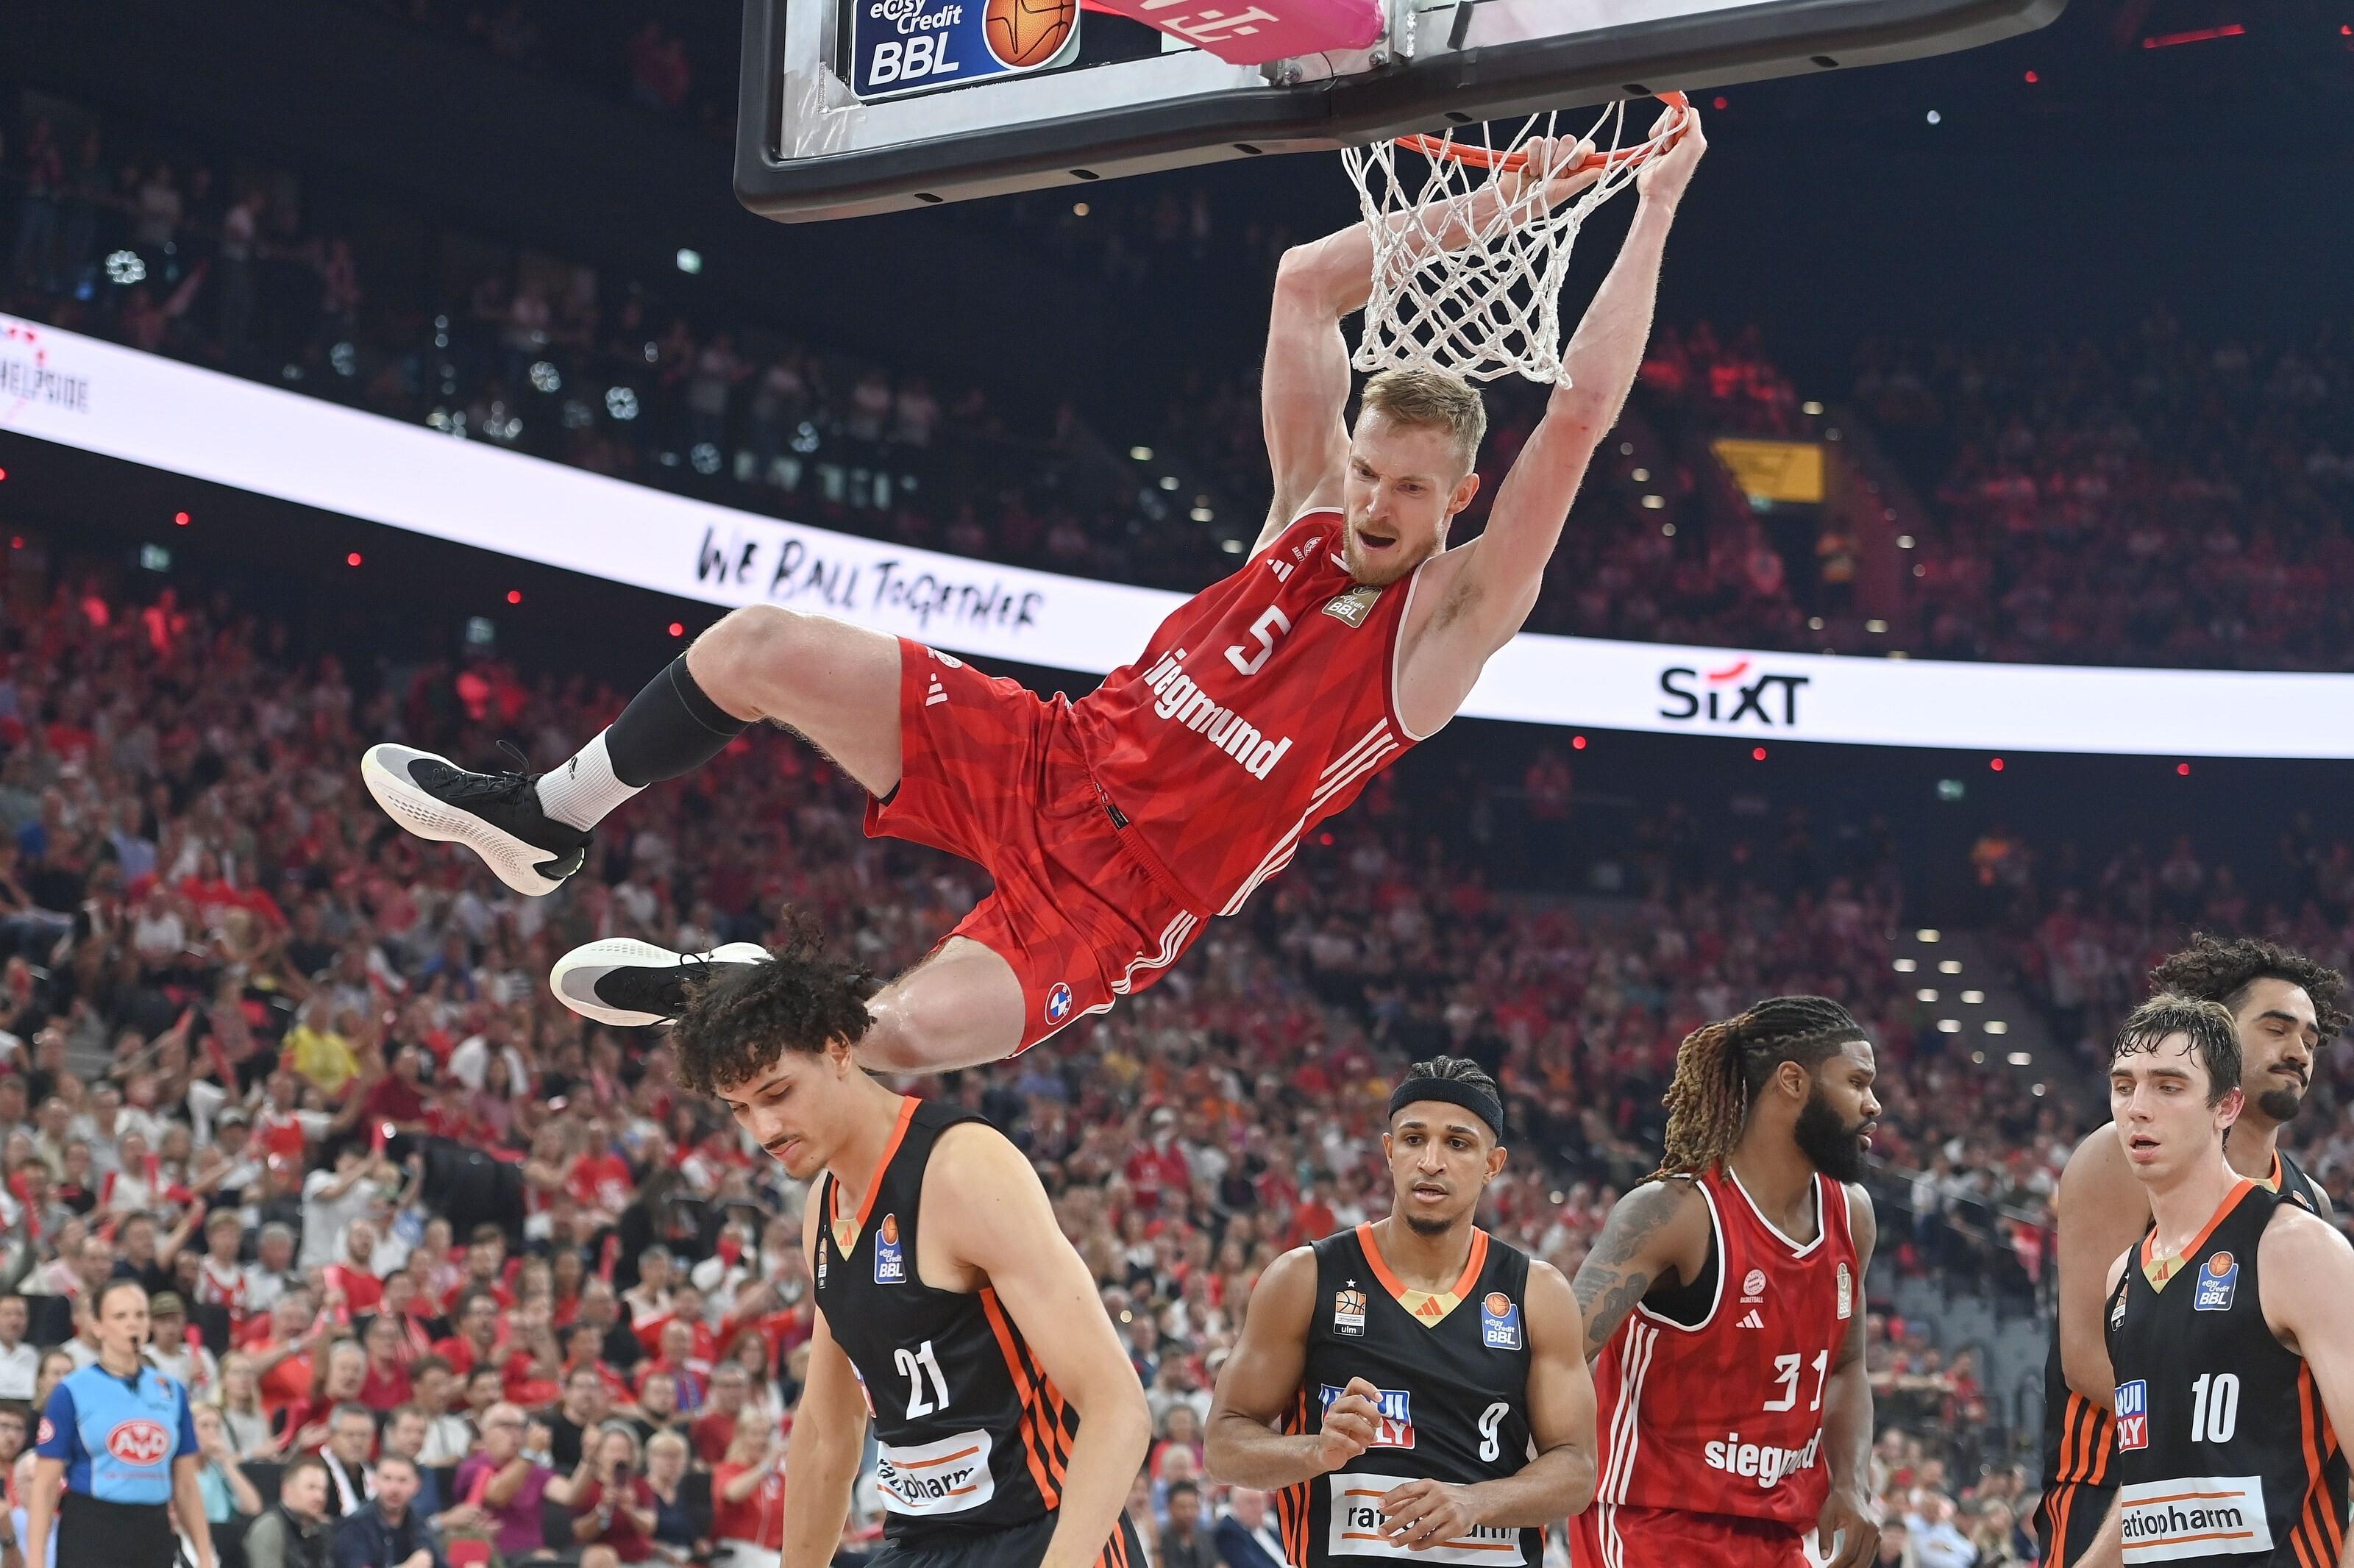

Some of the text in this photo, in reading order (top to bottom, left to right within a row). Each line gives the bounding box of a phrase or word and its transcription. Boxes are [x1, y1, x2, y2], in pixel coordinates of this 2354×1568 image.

[897, 4, 963, 35] Credit
[868, 32, 959, 86] BBL
[696, 524, 758, 585] WE
[769, 540, 863, 610] BALL
[1327, 602, 1356, 621] BBL
[1224, 605, 1292, 676] 5
[879, 1263, 903, 1277] BBL
[2199, 1291, 2227, 1305] BBL
[1341, 1325, 1357, 1334] ulm
[1487, 1330, 1516, 1345] BBL
[1494, 1325, 1515, 1333] Credit
[894, 1340, 949, 1421] 21
[1763, 1349, 1829, 1412] 31
[2191, 1372, 2239, 1444] 10
[1478, 1402, 1510, 1462] 9
[2122, 1505, 2244, 1541] atiopharm
